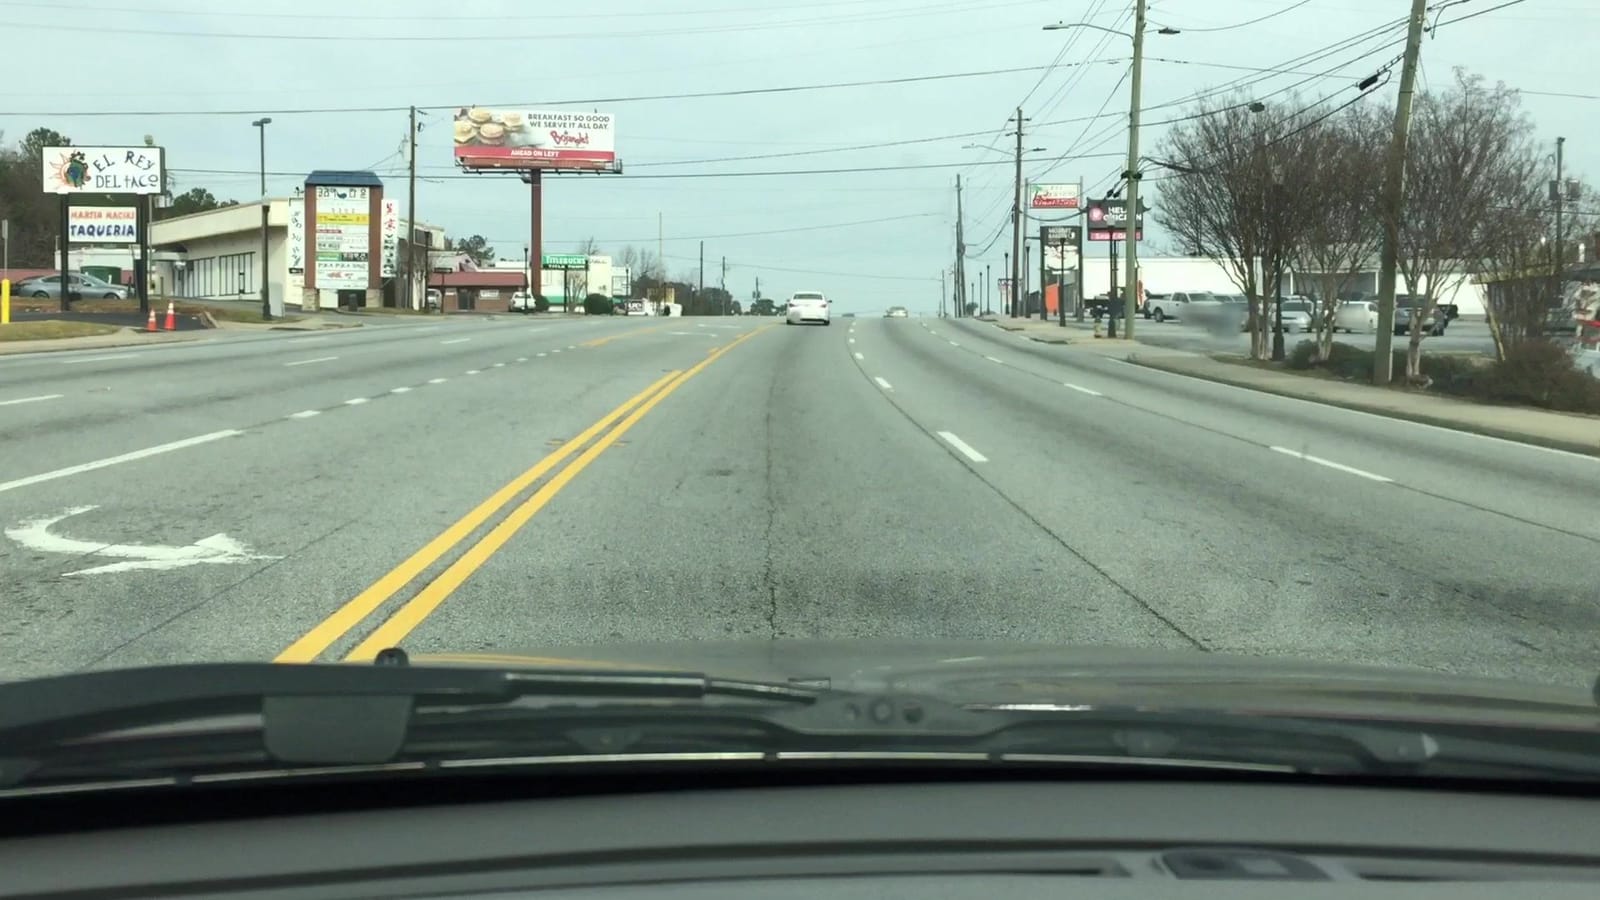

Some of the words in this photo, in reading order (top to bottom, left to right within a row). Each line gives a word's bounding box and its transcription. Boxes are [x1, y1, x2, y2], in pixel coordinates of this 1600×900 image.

[528, 113, 571, 121] BREAKFAST
[93, 154, 115, 172] EL
[125, 150, 156, 171] REY
[96, 175, 121, 188] DEL
[70, 224, 135, 237] TAQUERIA
